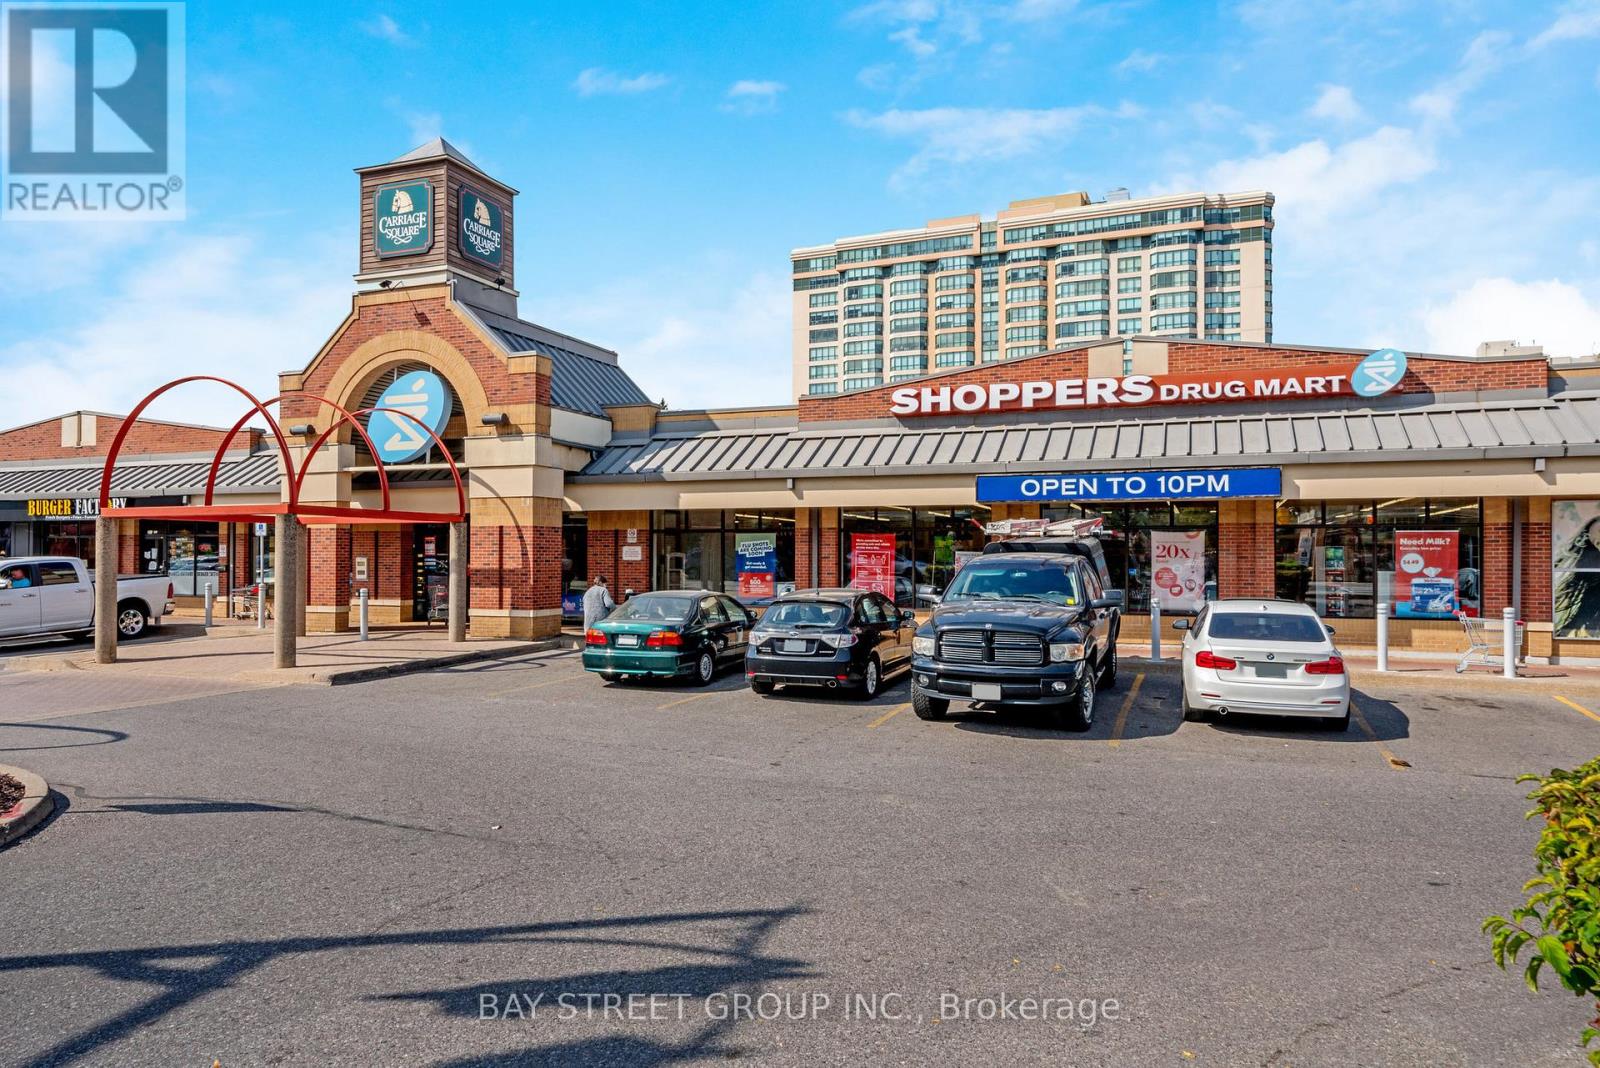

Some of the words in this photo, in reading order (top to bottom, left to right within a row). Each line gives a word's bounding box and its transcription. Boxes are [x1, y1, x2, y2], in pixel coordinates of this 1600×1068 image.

[380, 212, 427, 233] CARRIAGE
[386, 225, 420, 240] SQUARE
[464, 218, 501, 248] CARRIAGE
[469, 232, 496, 252] SQUARE
[890, 374, 1154, 414] SHOPPERS
[1160, 380, 1246, 401] DRUG
[1254, 375, 1346, 396] MART
[1021, 478, 1098, 496] OPEN
[1106, 477, 1146, 495] TO
[1157, 474, 1230, 494] 10PM
[28, 499, 72, 516] BURGER
[1426, 537, 1451, 545] Milk?
